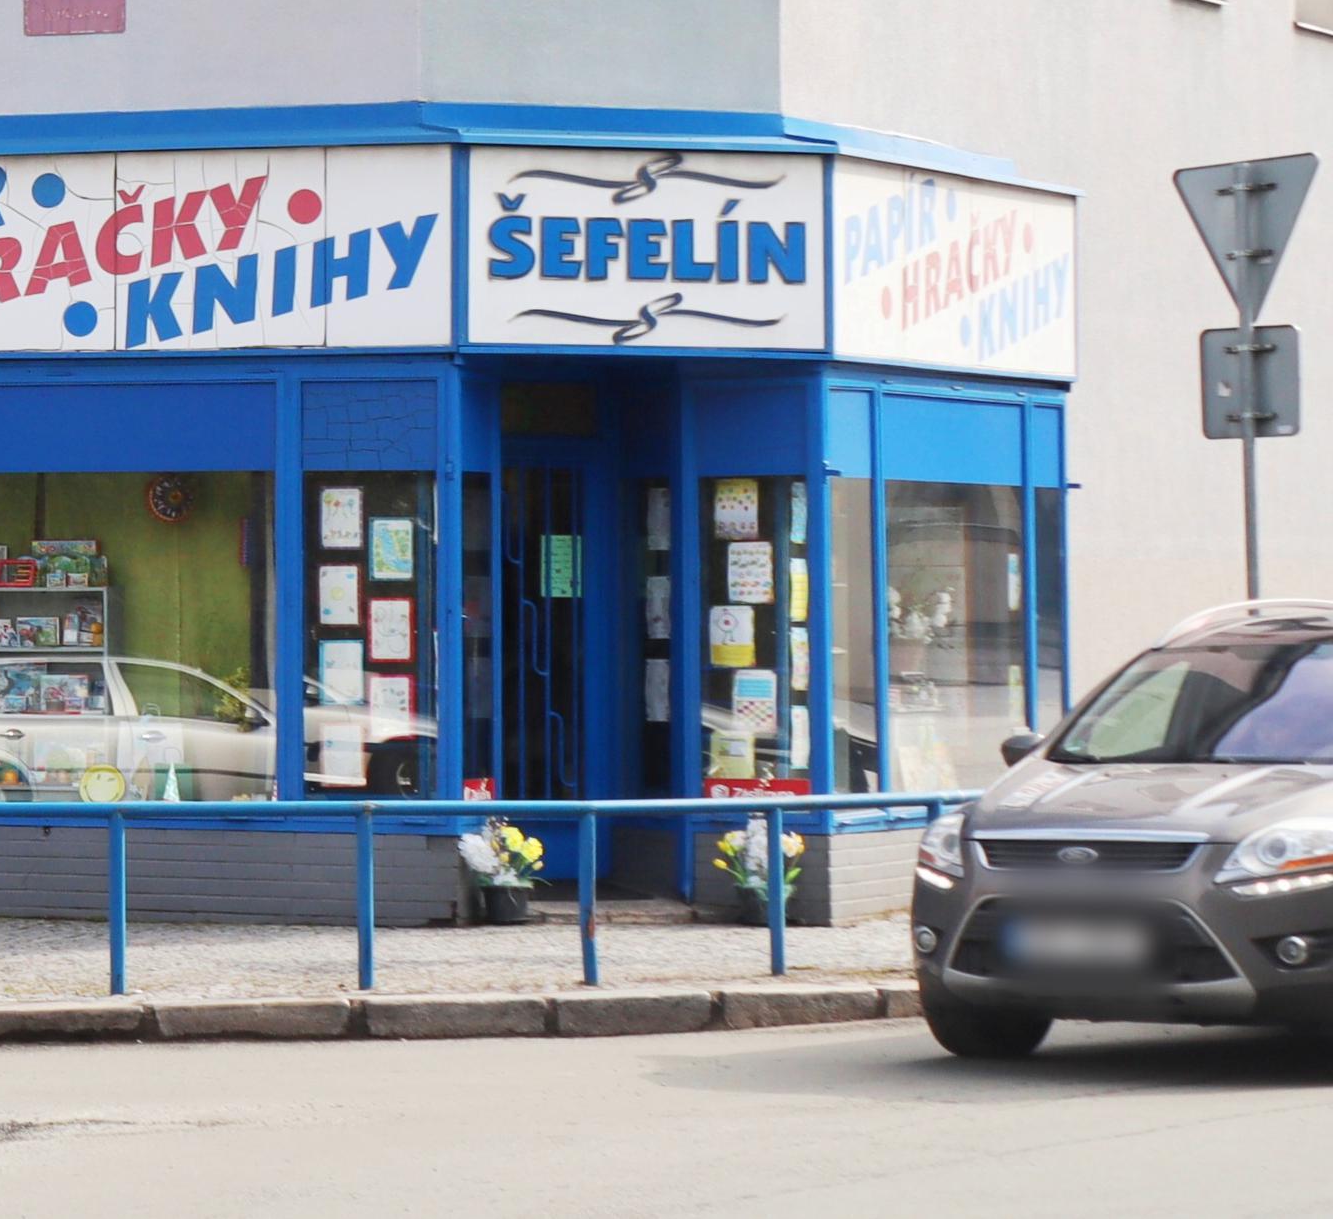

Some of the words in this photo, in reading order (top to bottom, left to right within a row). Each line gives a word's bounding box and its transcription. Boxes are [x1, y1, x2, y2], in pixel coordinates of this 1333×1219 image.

[125, 212, 440, 350] KNIHY
[487, 192, 807, 285] ŠEFELÍN
[844, 172, 936, 285] PAPÍR
[900, 208, 1018, 331] HRAČKY
[978, 251, 1070, 362] KNIHY
